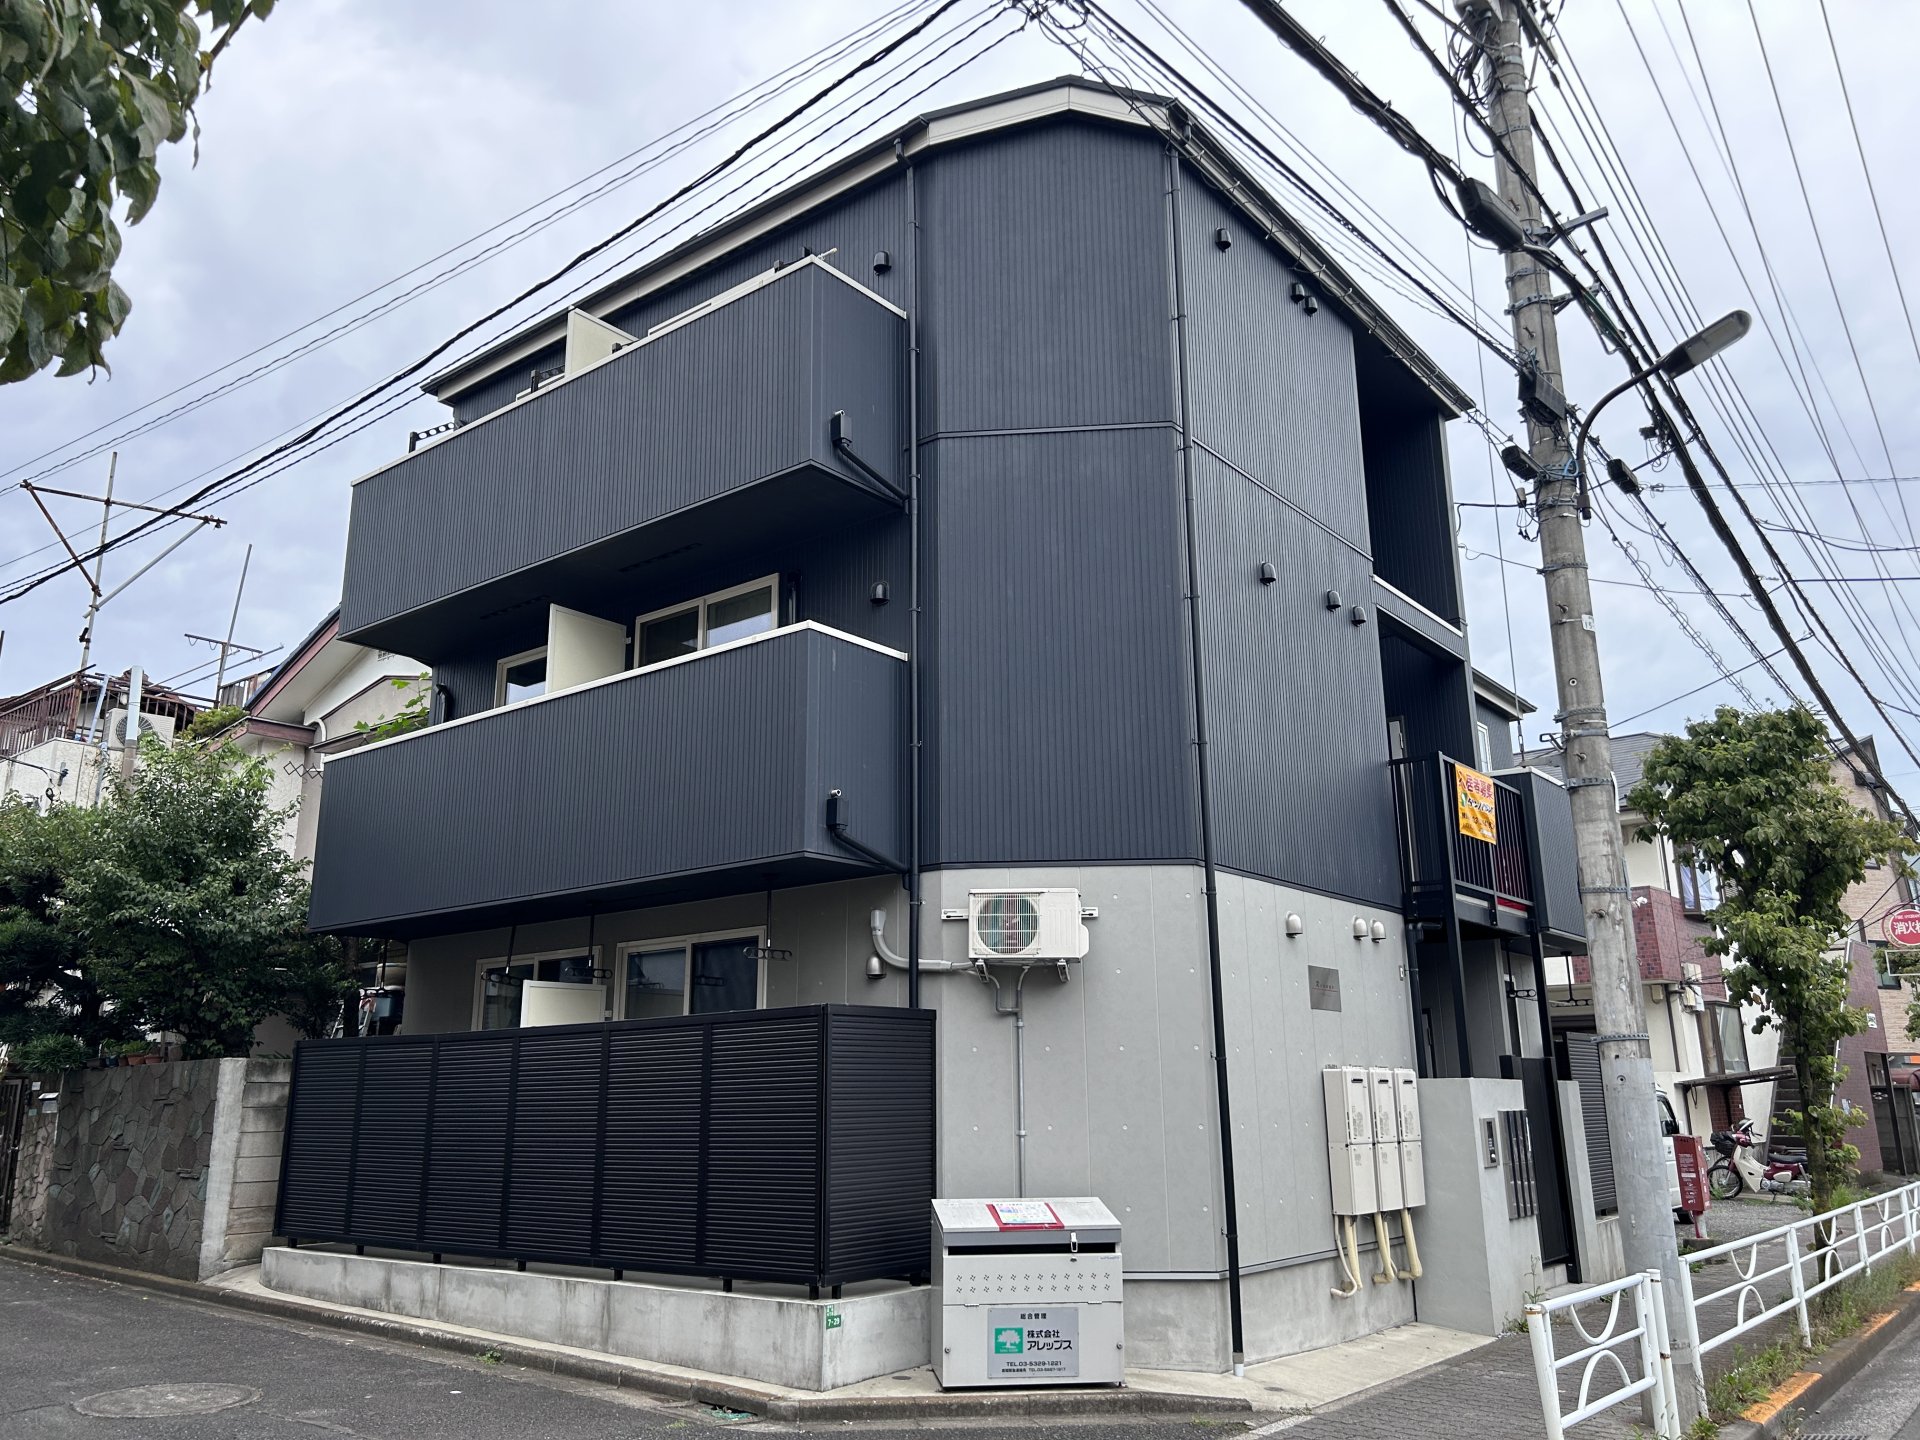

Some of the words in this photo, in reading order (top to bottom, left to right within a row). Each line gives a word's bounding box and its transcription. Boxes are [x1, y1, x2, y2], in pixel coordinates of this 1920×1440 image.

[1457, 769, 1494, 800] 入居者募集
[1027, 1329, 1060, 1339] 株式会社
[1027, 1340, 1073, 1350] アレップス
